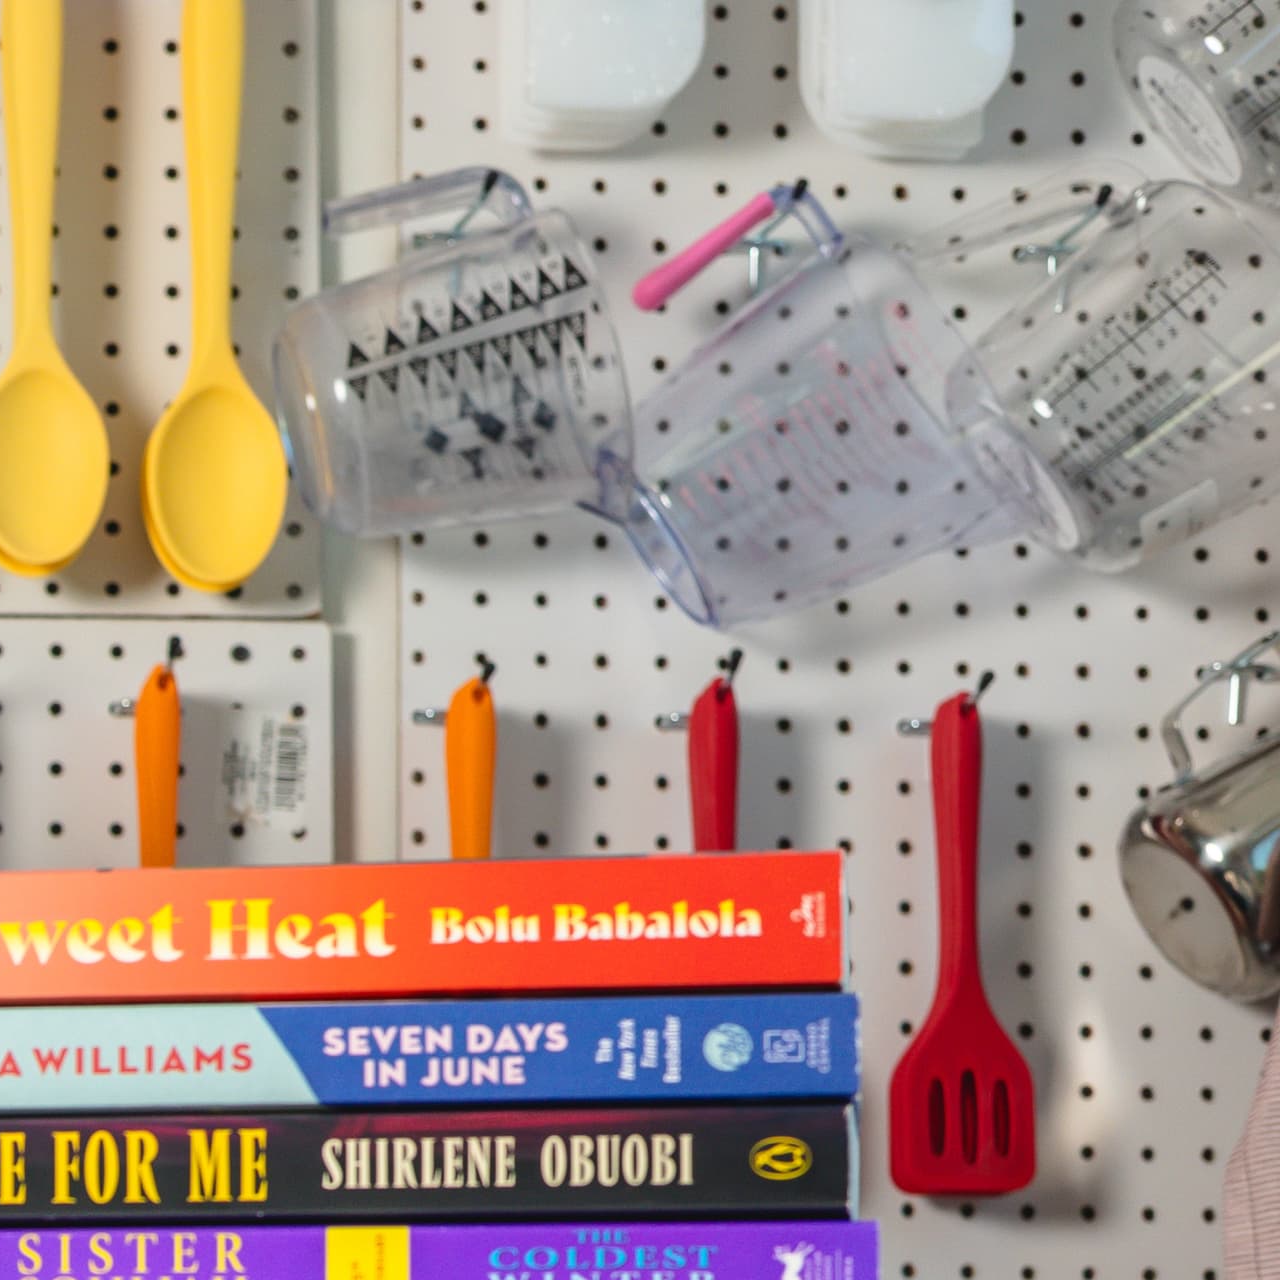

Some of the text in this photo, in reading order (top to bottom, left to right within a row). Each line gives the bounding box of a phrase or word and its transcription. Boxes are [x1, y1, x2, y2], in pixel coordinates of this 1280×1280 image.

[203, 898, 397, 961] Heat
[429, 904, 540, 945] Bolu
[553, 898, 763, 942] Babalola
[33, 1043, 253, 1075] WILLIAMS
[322, 1022, 569, 1057] SEVEN DAYS
[595, 1037, 614, 1064] The
[618, 1017, 637, 1081] New York
[640, 1027, 658, 1069] Times
[662, 1014, 682, 1084] Bestseller
[363, 1056, 527, 1088] IN JUNE
[51, 1129, 161, 1205] FOR
[185, 1128, 269, 1204] ME
[321, 1133, 694, 1191] SHIRLENE OBUOBI
[17, 1231, 247, 1275] SISTER
[487, 1244, 719, 1270] COLDEST
[574, 1228, 630, 1245] THE
